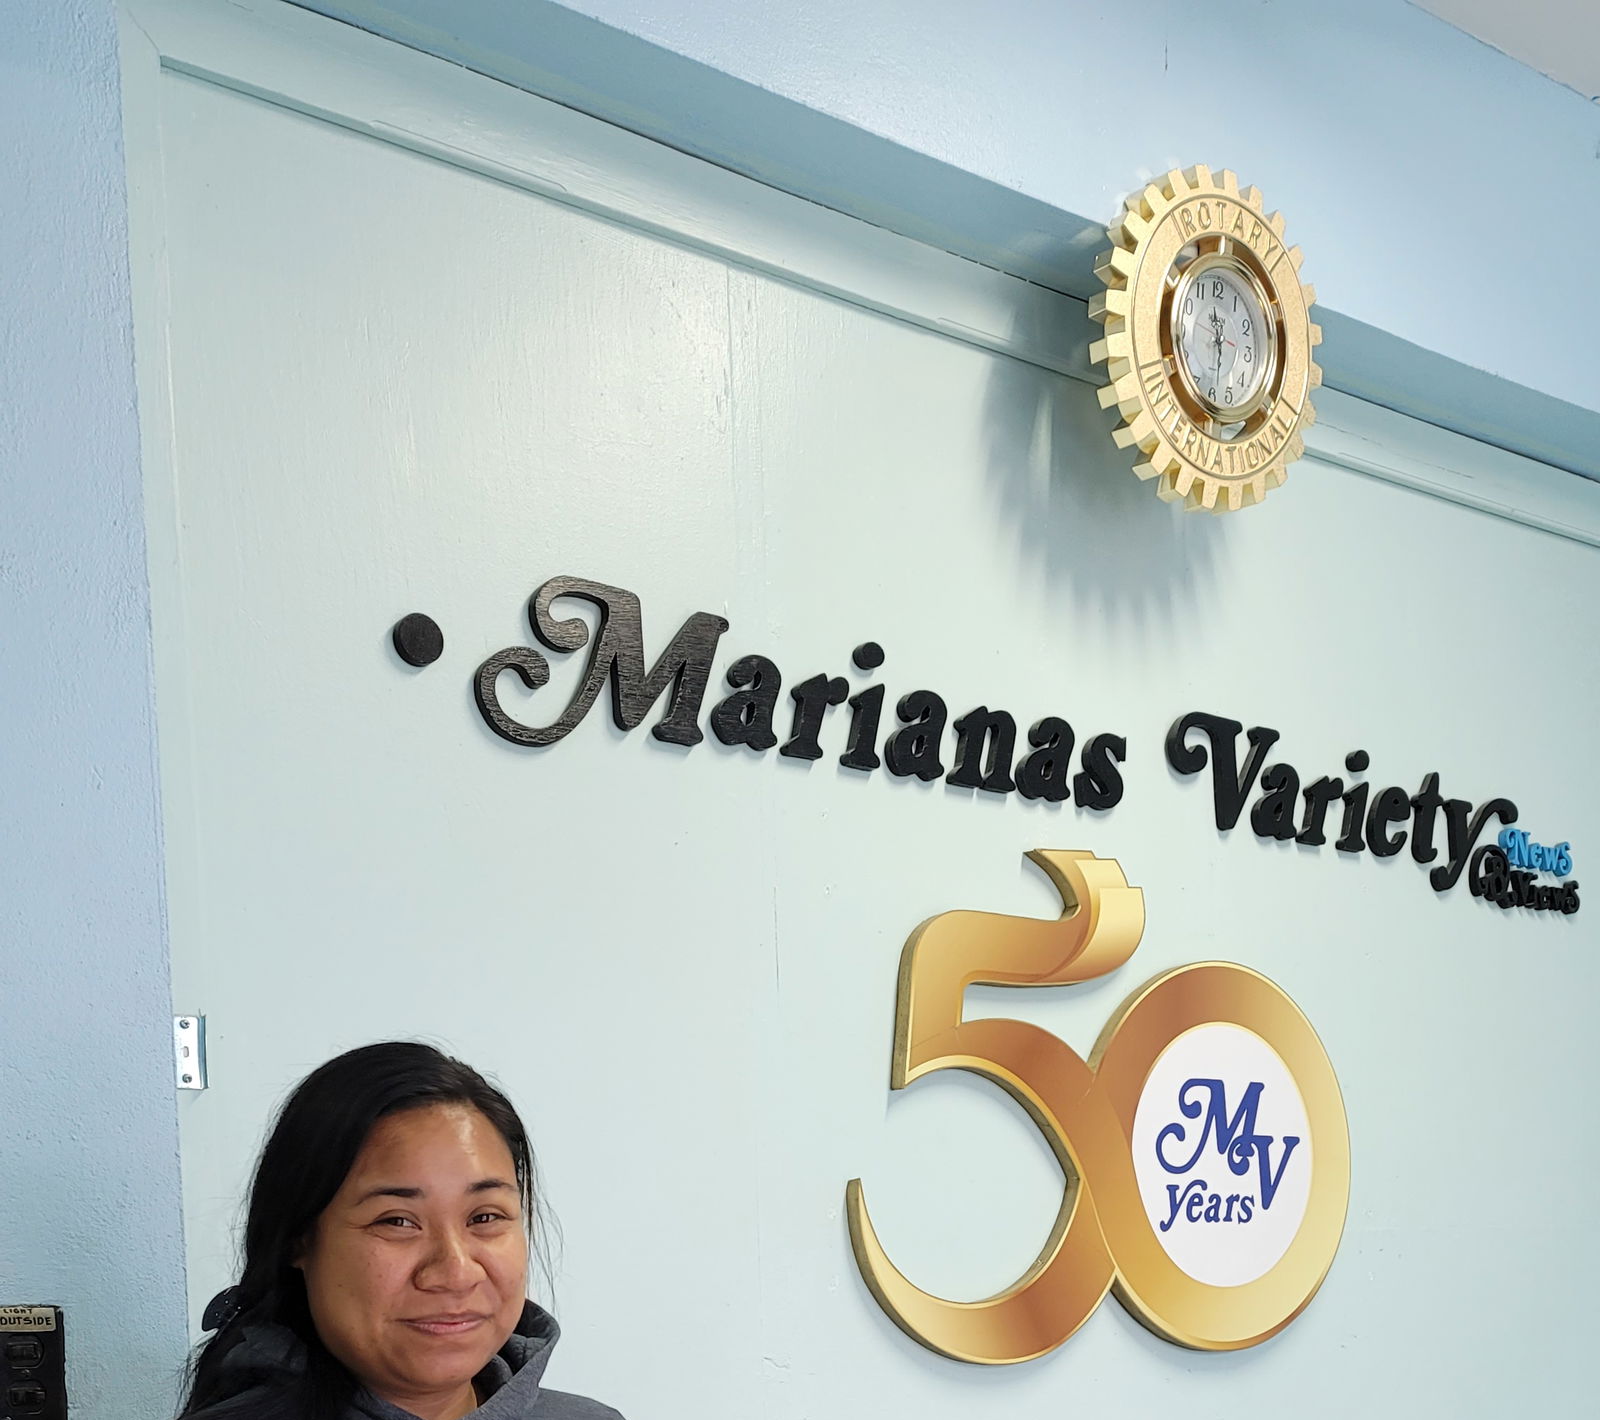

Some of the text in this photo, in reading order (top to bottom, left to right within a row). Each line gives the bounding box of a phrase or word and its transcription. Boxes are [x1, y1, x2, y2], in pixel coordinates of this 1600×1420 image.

[1179, 201, 1278, 262] ROTARY
[1196, 282, 1205, 300] 11
[1212, 280, 1224, 300] 12
[1185, 298, 1194, 315] 0
[1242, 319, 1250, 337] 2
[1243, 346, 1252, 363] 3
[1238, 371, 1245, 388] 4
[1225, 386, 1233, 404] 5
[1142, 369, 1296, 474] INTERNATIONAL
[472, 574, 1519, 893] Marianas Variety
[1498, 828, 1573, 877] News
[846, 848, 1351, 1365] 50
[1156, 1078, 1300, 1210] MV
[0, 1316, 52, 1326] OUTSIDE
